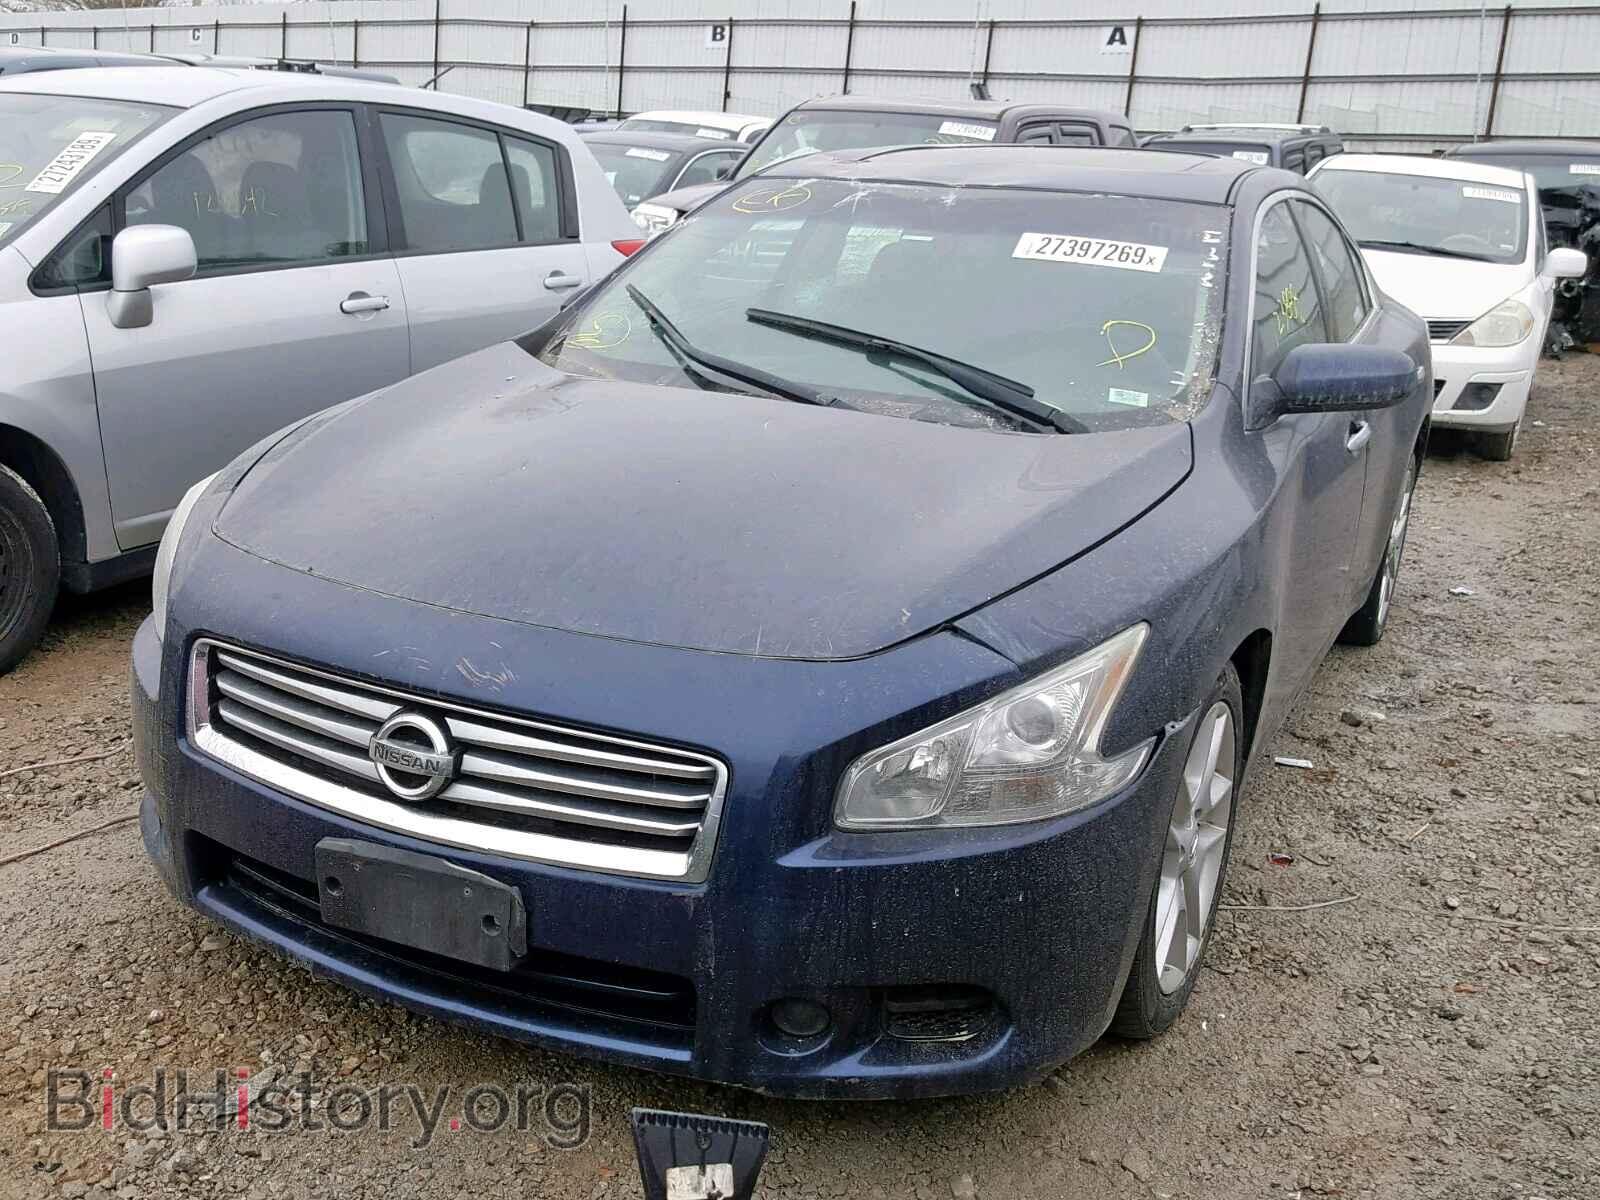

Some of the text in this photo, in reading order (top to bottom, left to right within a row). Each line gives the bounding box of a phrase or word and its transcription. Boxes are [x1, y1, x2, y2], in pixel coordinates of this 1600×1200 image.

[192, 28, 200, 41] C
[711, 25, 725, 41] B
[1106, 25, 1127, 45] A
[374, 743, 440, 772] NISSAN
